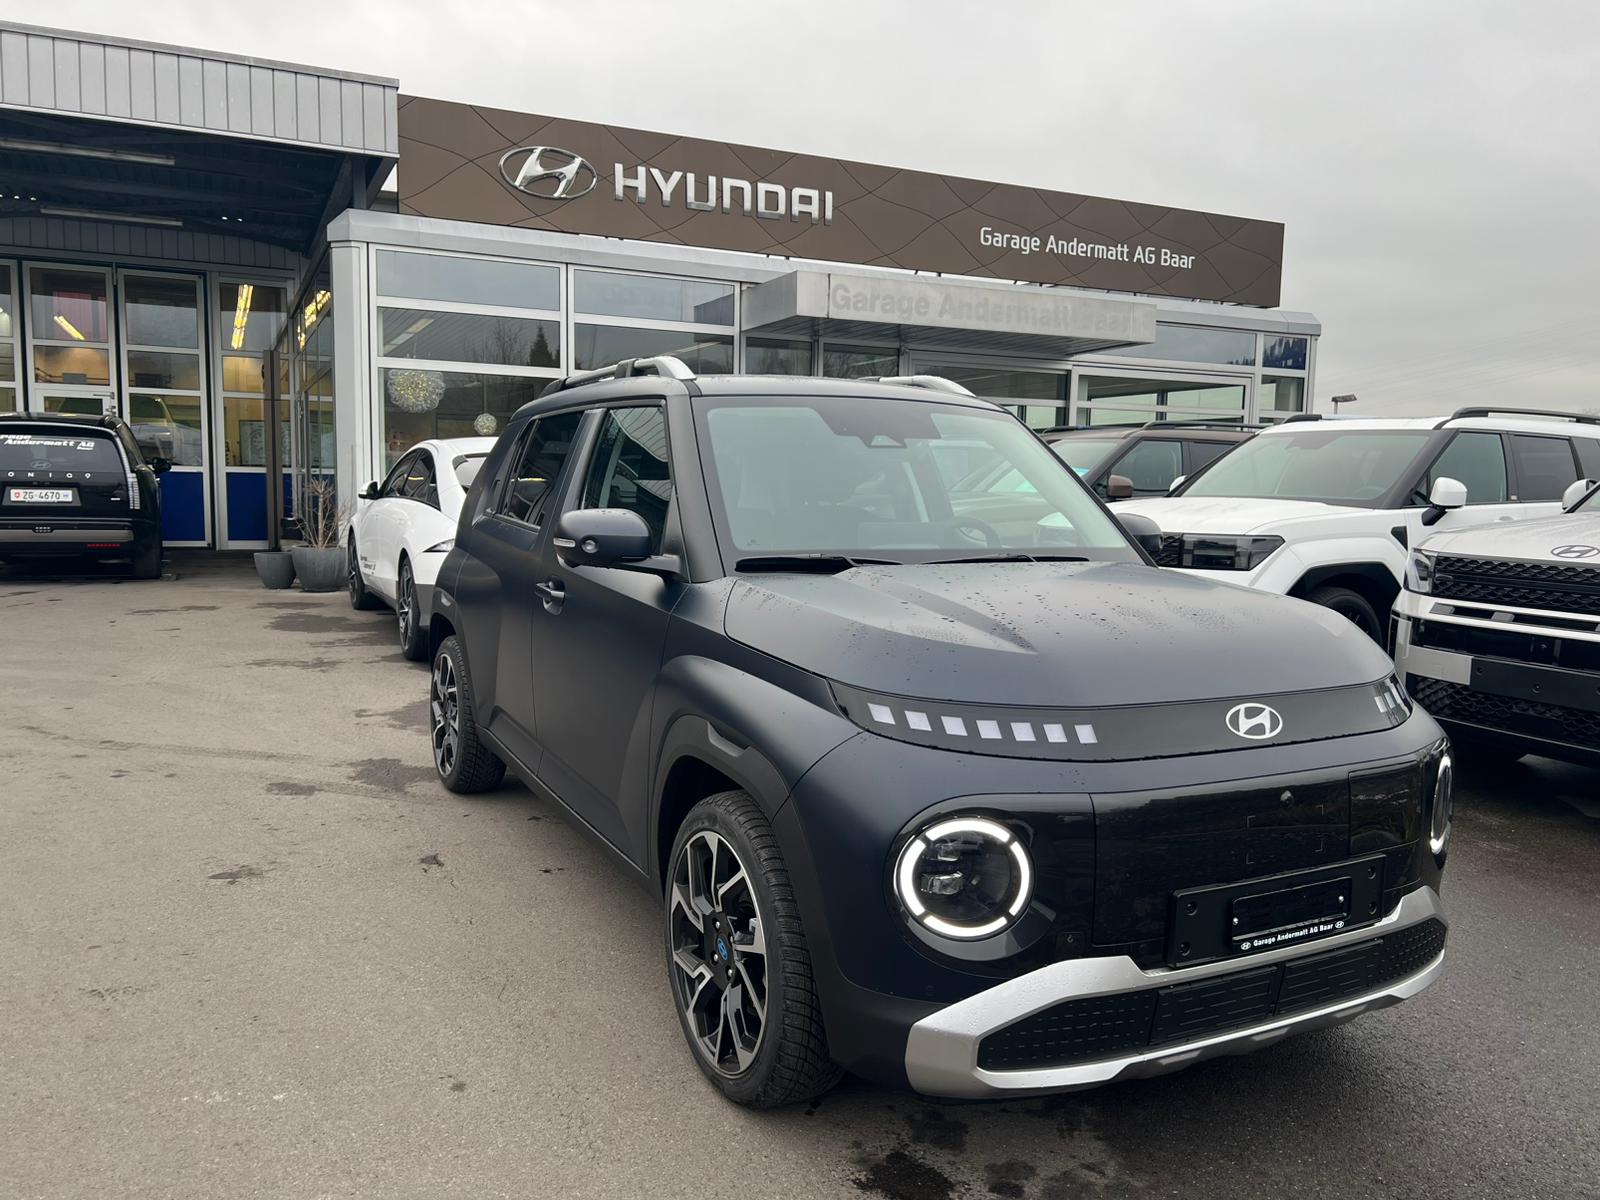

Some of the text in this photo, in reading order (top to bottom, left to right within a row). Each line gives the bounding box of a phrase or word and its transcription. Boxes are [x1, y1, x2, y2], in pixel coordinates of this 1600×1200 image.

[614, 162, 833, 226] HYUNDAI
[979, 226, 1196, 269] Garage Andermatt AG Baar
[831, 283, 930, 321] Garage
[1253, 923, 1334, 947] Garage Andermatt AG Baar
